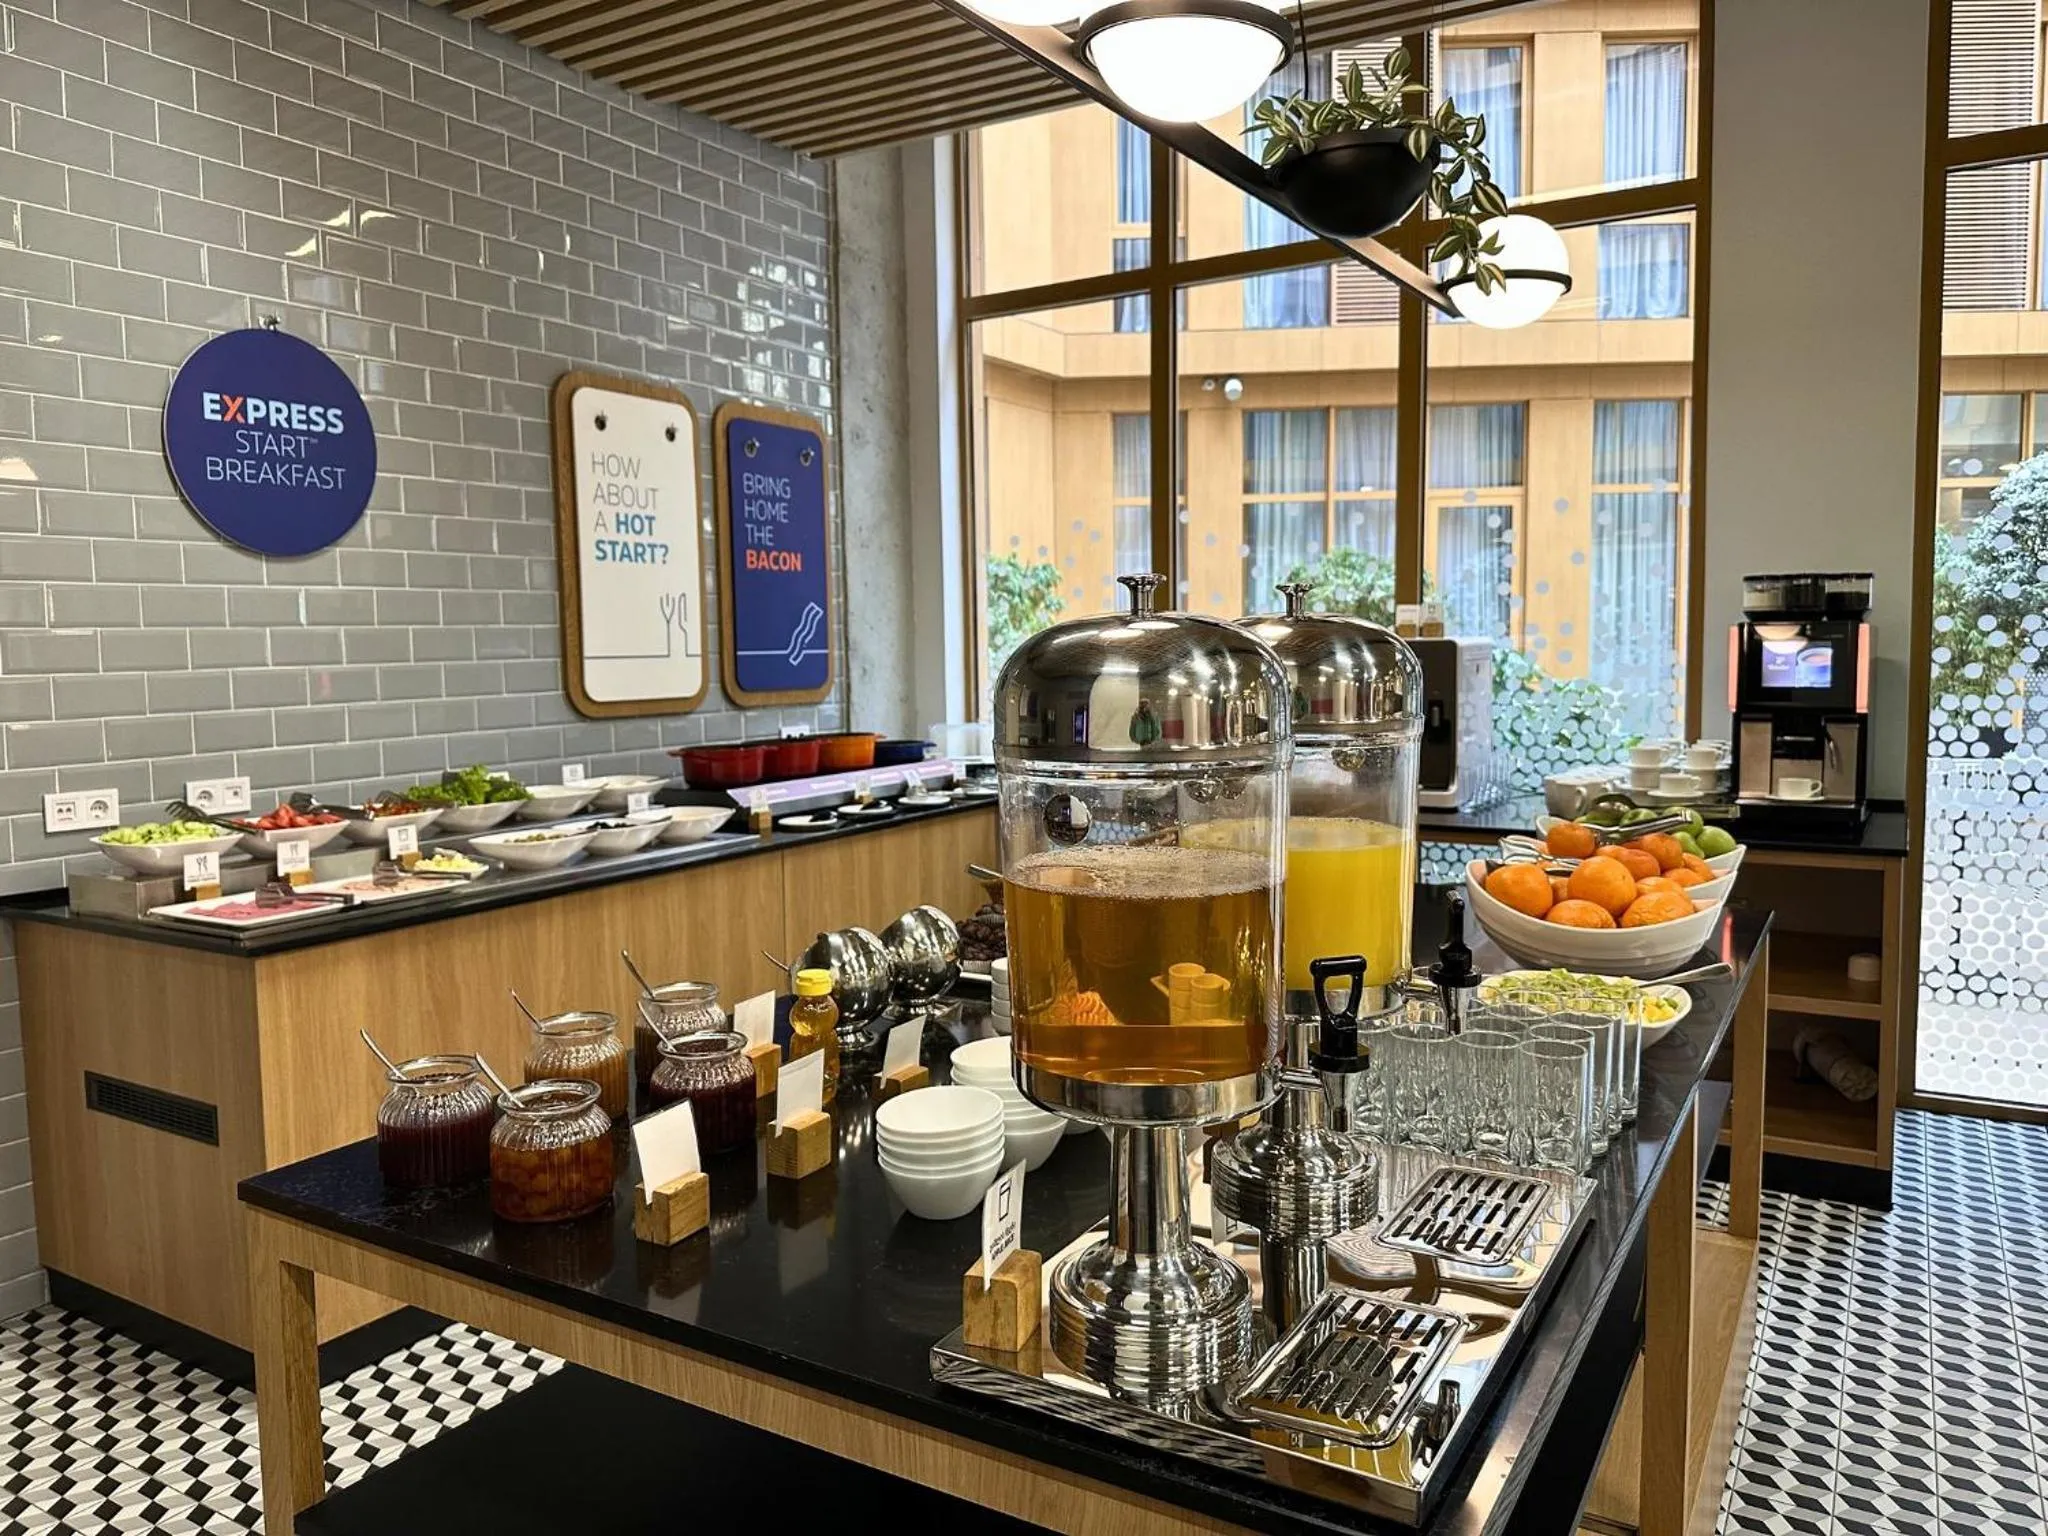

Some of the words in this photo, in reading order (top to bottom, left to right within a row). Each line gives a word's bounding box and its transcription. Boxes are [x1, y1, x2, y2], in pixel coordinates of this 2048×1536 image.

[202, 391, 344, 435] EXPRESS
[206, 456, 346, 490] BREAKFAST
[592, 451, 640, 479] HOW
[593, 482, 659, 510] ABOUT
[742, 472, 791, 500] BRING
[594, 511, 608, 533] A
[615, 512, 656, 537] HOT
[744, 499, 789, 523] HOME
[745, 523, 774, 546] THE
[595, 539, 669, 566] START?
[746, 549, 802, 572] BACON
